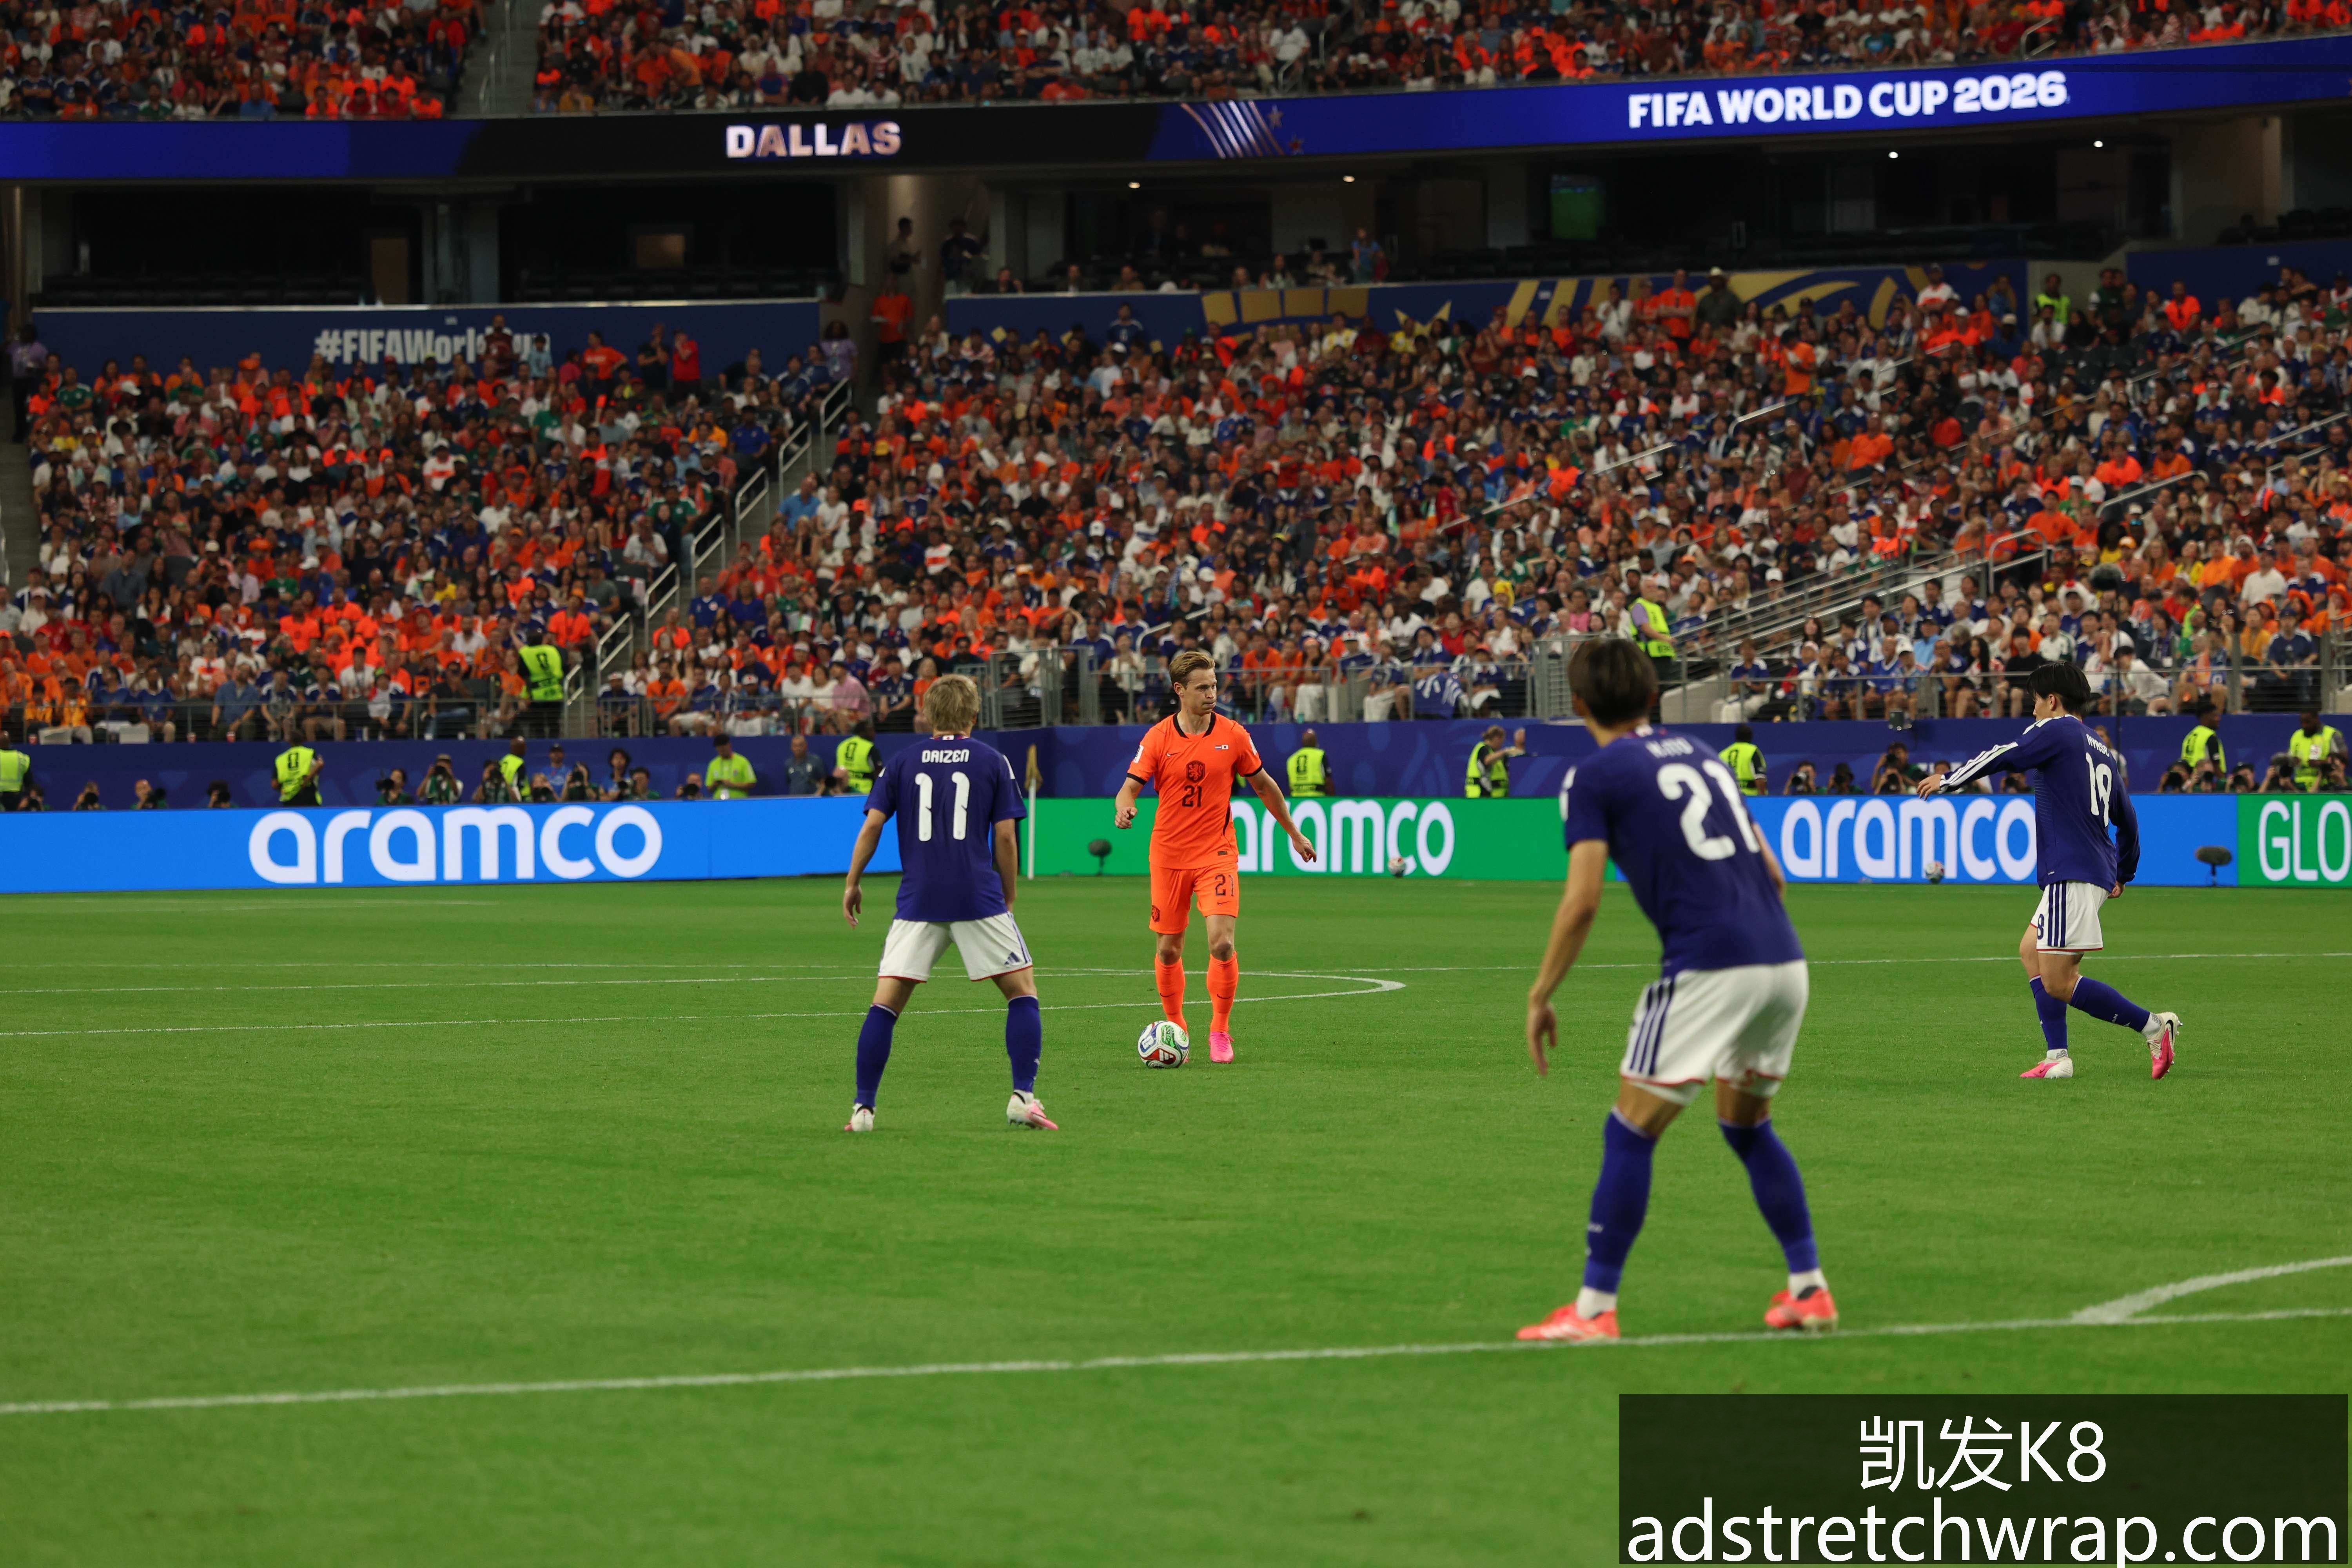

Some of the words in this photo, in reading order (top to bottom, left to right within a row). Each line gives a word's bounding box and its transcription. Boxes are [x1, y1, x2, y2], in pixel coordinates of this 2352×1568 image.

[1628, 92, 1713, 128] FIFA
[1717, 84, 1863, 124] WORLD
[1868, 80, 1949, 118] CUP
[1953, 71, 2068, 113] 2026
[726, 121, 901, 158] DALLAS
[921, 749, 970, 763] DAIZEN
[2086, 733, 2110, 757] AYASE
[915, 771, 970, 842] 11
[1182, 785, 1202, 808] 21
[1657, 759, 1760, 860] 21
[249, 806, 662, 884] aramco
[1230, 800, 1454, 875] aramco
[1781, 798, 2037, 880] aramco
[2259, 800, 2352, 882] GLO
[1215, 874, 1234, 897] 21
